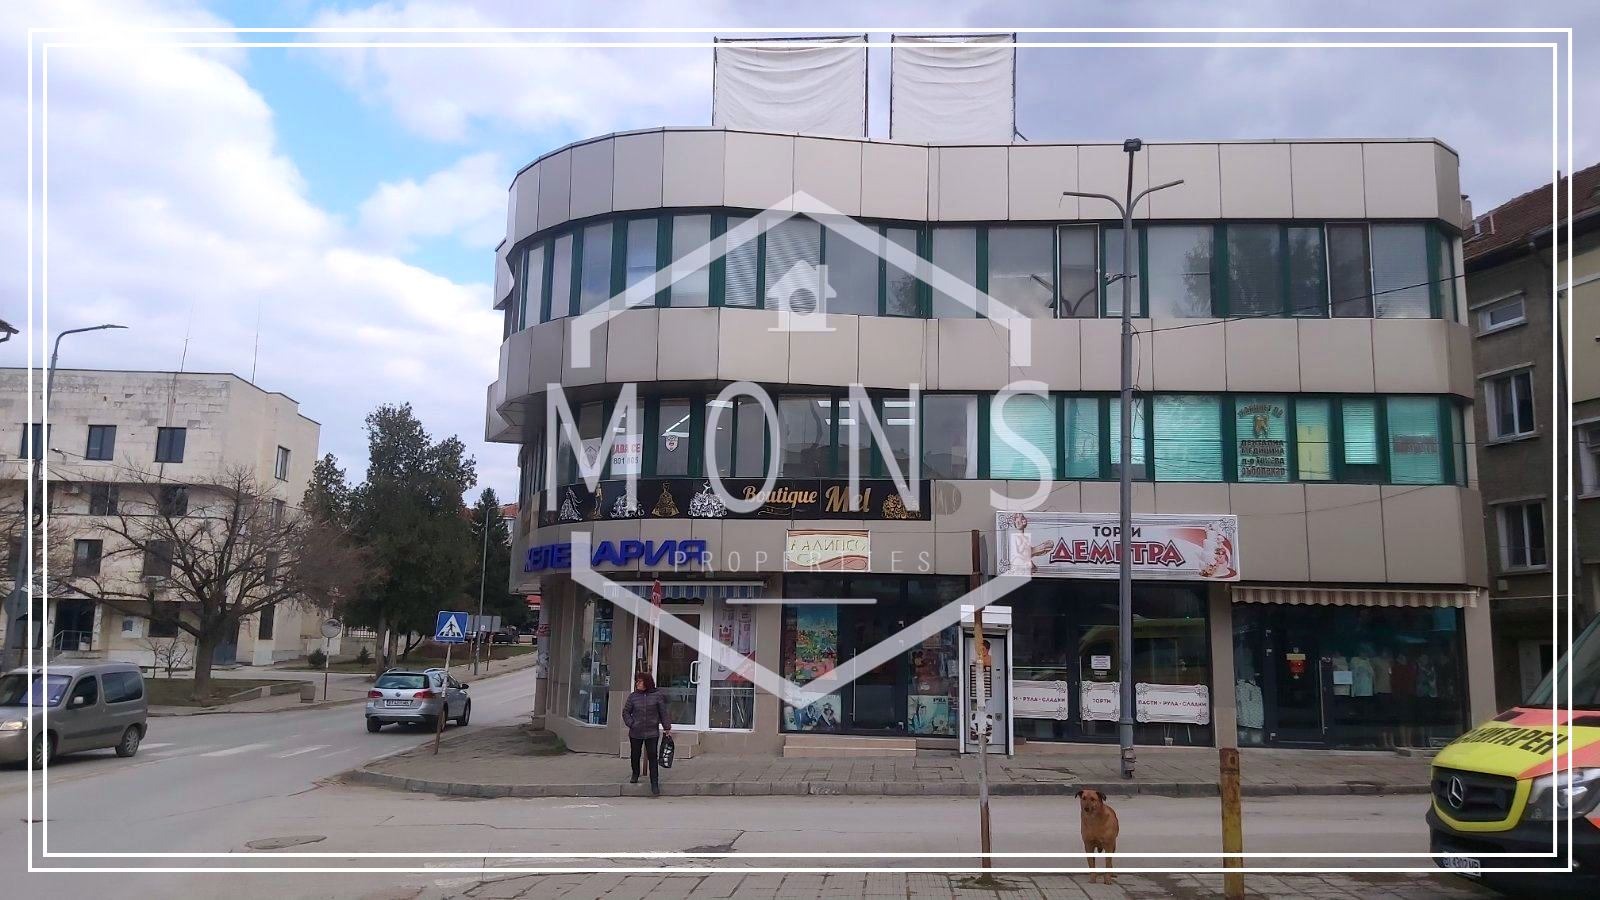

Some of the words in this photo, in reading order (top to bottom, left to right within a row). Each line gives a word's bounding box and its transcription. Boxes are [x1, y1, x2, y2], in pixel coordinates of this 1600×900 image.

[742, 485, 818, 508] Boutique
[825, 485, 871, 513] Mel
[1092, 525, 1142, 538] ТОРИ
[524, 539, 707, 573] ЕЛЕАРИЯ
